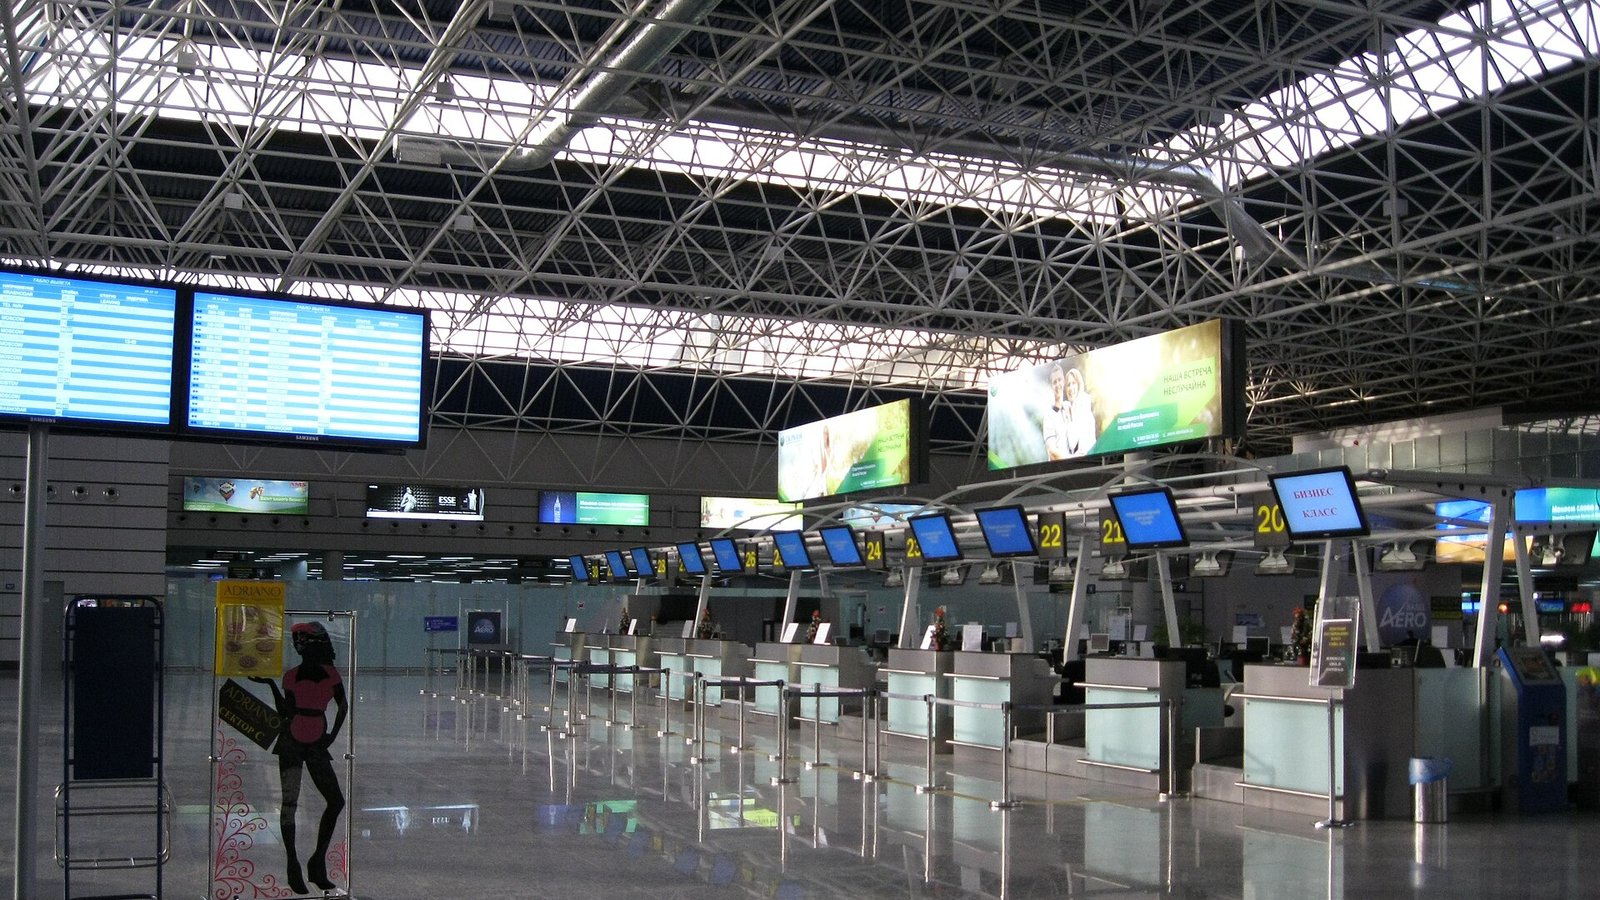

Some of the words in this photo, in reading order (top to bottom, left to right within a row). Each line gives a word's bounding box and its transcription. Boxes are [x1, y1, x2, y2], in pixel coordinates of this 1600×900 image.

[1163, 373, 1183, 384] НАША
[1184, 365, 1213, 380] ВСТРЕЧА
[438, 496, 457, 504] ESSE
[1293, 487, 1334, 499] БИЗНЕС
[1258, 504, 1285, 532] 20
[1302, 506, 1338, 518] КЛАСС
[1041, 524, 1061, 547] 22
[1103, 519, 1125, 543] 21
[745, 551, 756, 567] 26
[773, 549, 784, 565] 2
[867, 541, 882, 560] 24
[223, 586, 282, 597] ADRIANO
[1380, 604, 1428, 627] AERO
[223, 685, 281, 729] ADRIANO
[219, 706, 255, 734] СЕКТОР
